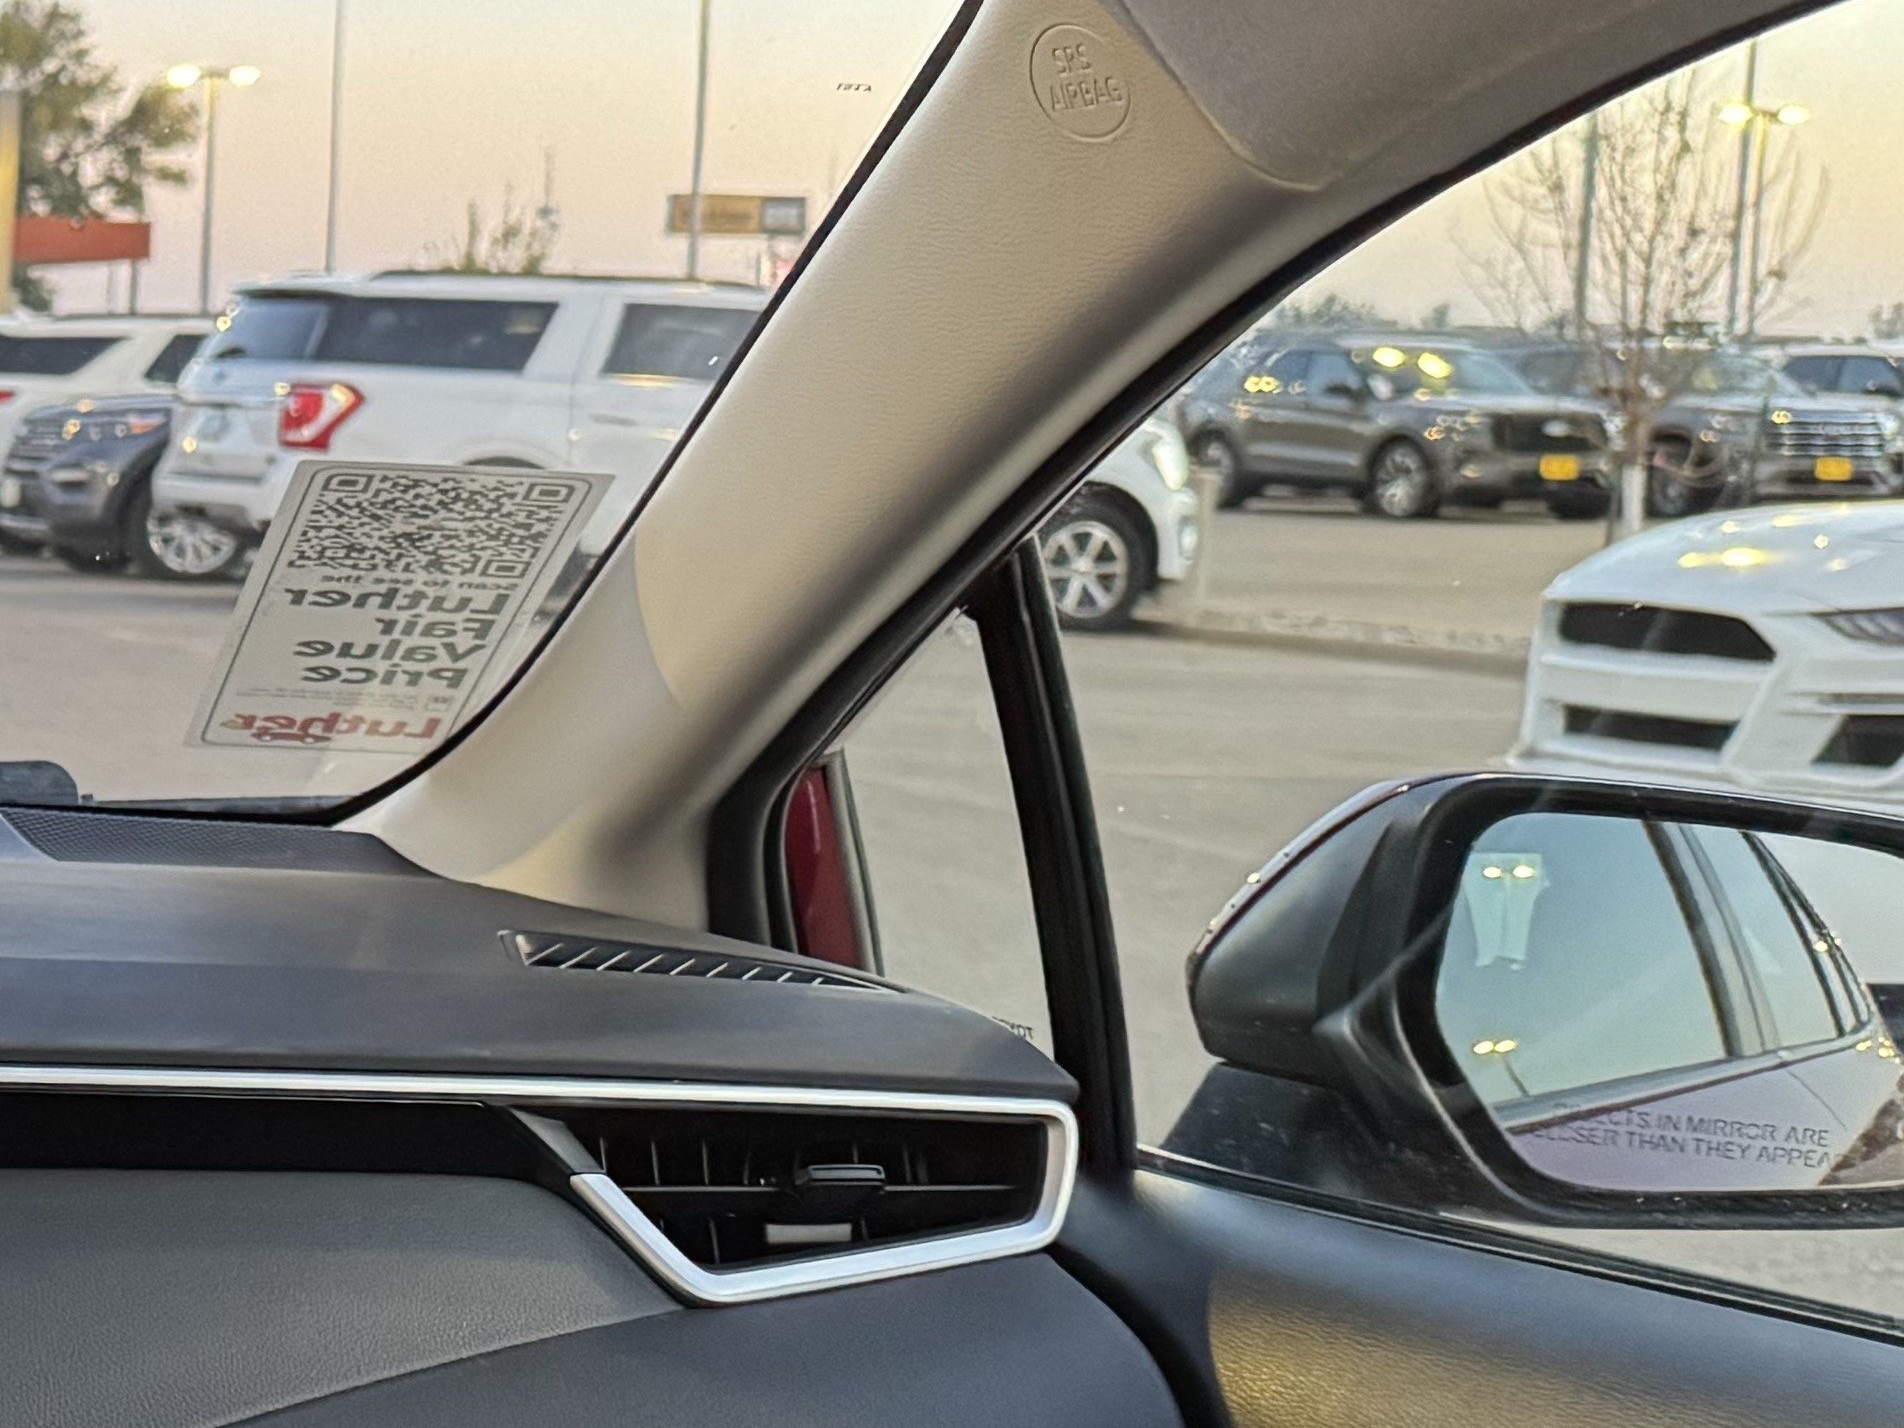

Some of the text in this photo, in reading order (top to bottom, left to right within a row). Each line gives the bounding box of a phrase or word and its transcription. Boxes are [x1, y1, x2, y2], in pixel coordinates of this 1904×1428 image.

[1655, 1112, 1681, 1131] IN
[1689, 1116, 1777, 1142] MIRROR
[1784, 1126, 1831, 1149] ARE
[1624, 1131, 1686, 1154] THAN
[1691, 1138, 1752, 1161] THEY
[1757, 1146, 1840, 1169] APPEA
